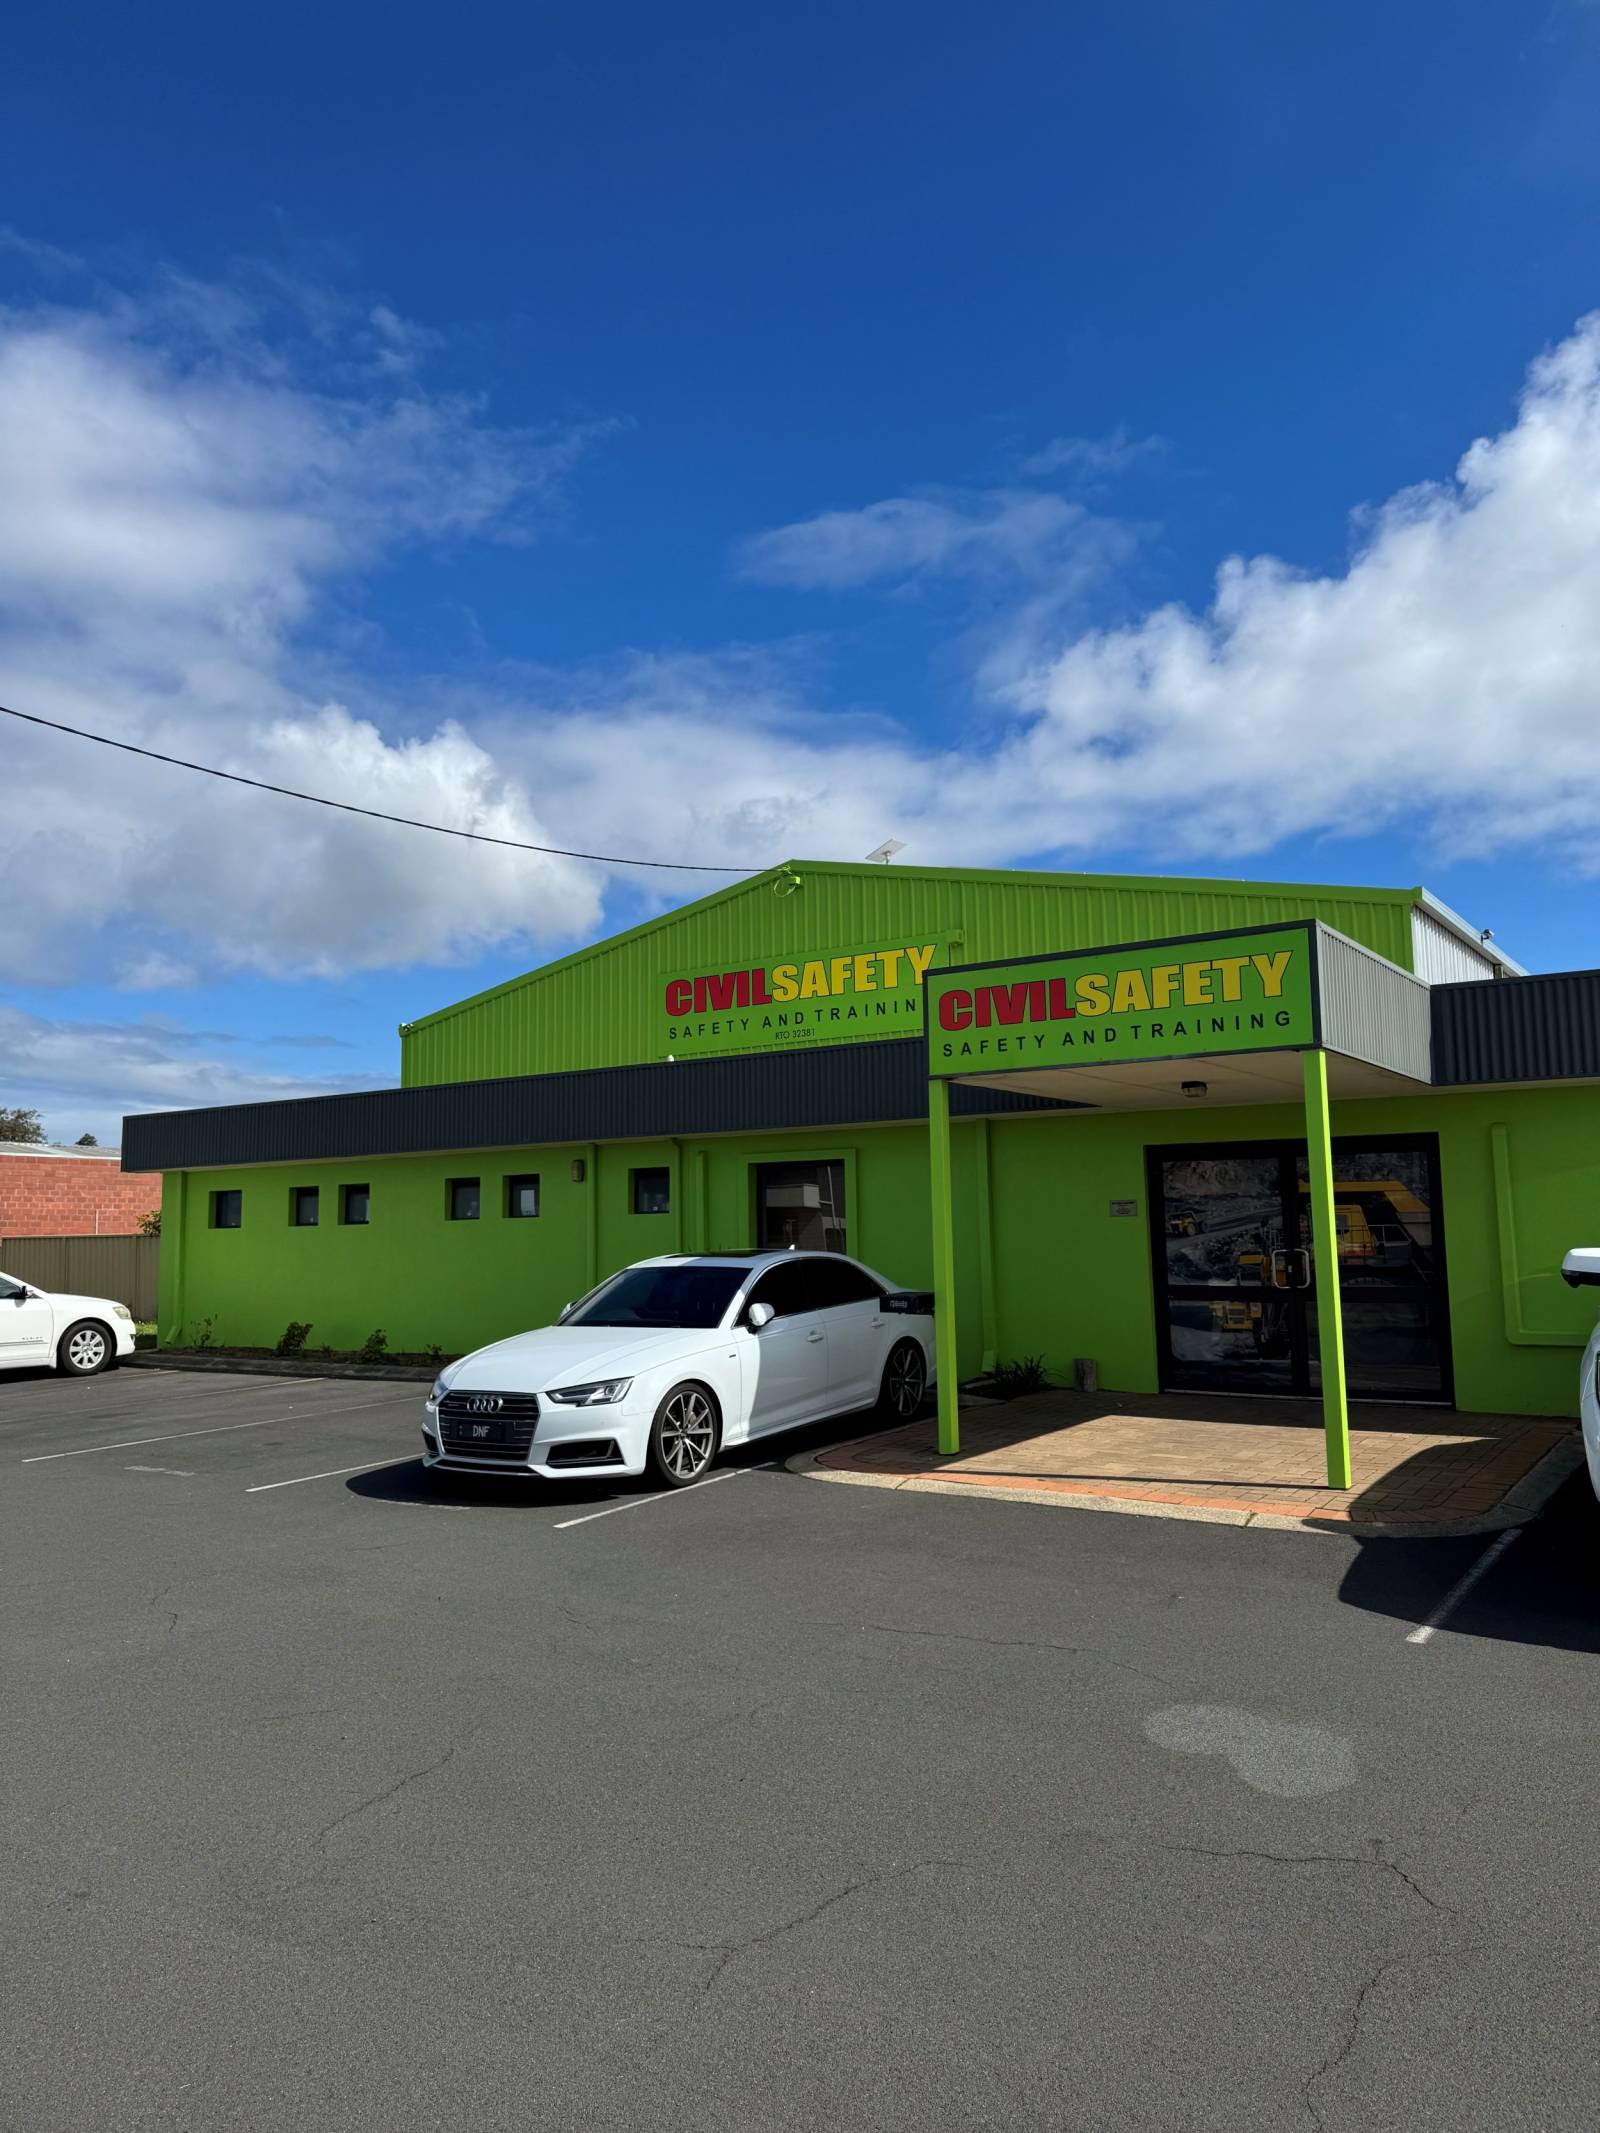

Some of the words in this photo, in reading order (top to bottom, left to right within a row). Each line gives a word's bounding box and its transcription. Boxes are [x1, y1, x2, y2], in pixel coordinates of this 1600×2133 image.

[665, 943, 937, 1017] CIVILSAFETY
[938, 950, 1293, 1032] CIVILSAFETY
[669, 1017, 750, 1040] SAFETY
[762, 1011, 805, 1029] AND
[815, 998, 917, 1023] TRAININ
[775, 1030, 790, 1040] RTO
[943, 1034, 1045, 1057] SAFETY
[1062, 1027, 1117, 1046] AND
[1130, 1010, 1291, 1040] TRAINING
[472, 1425, 491, 1438] DNF
